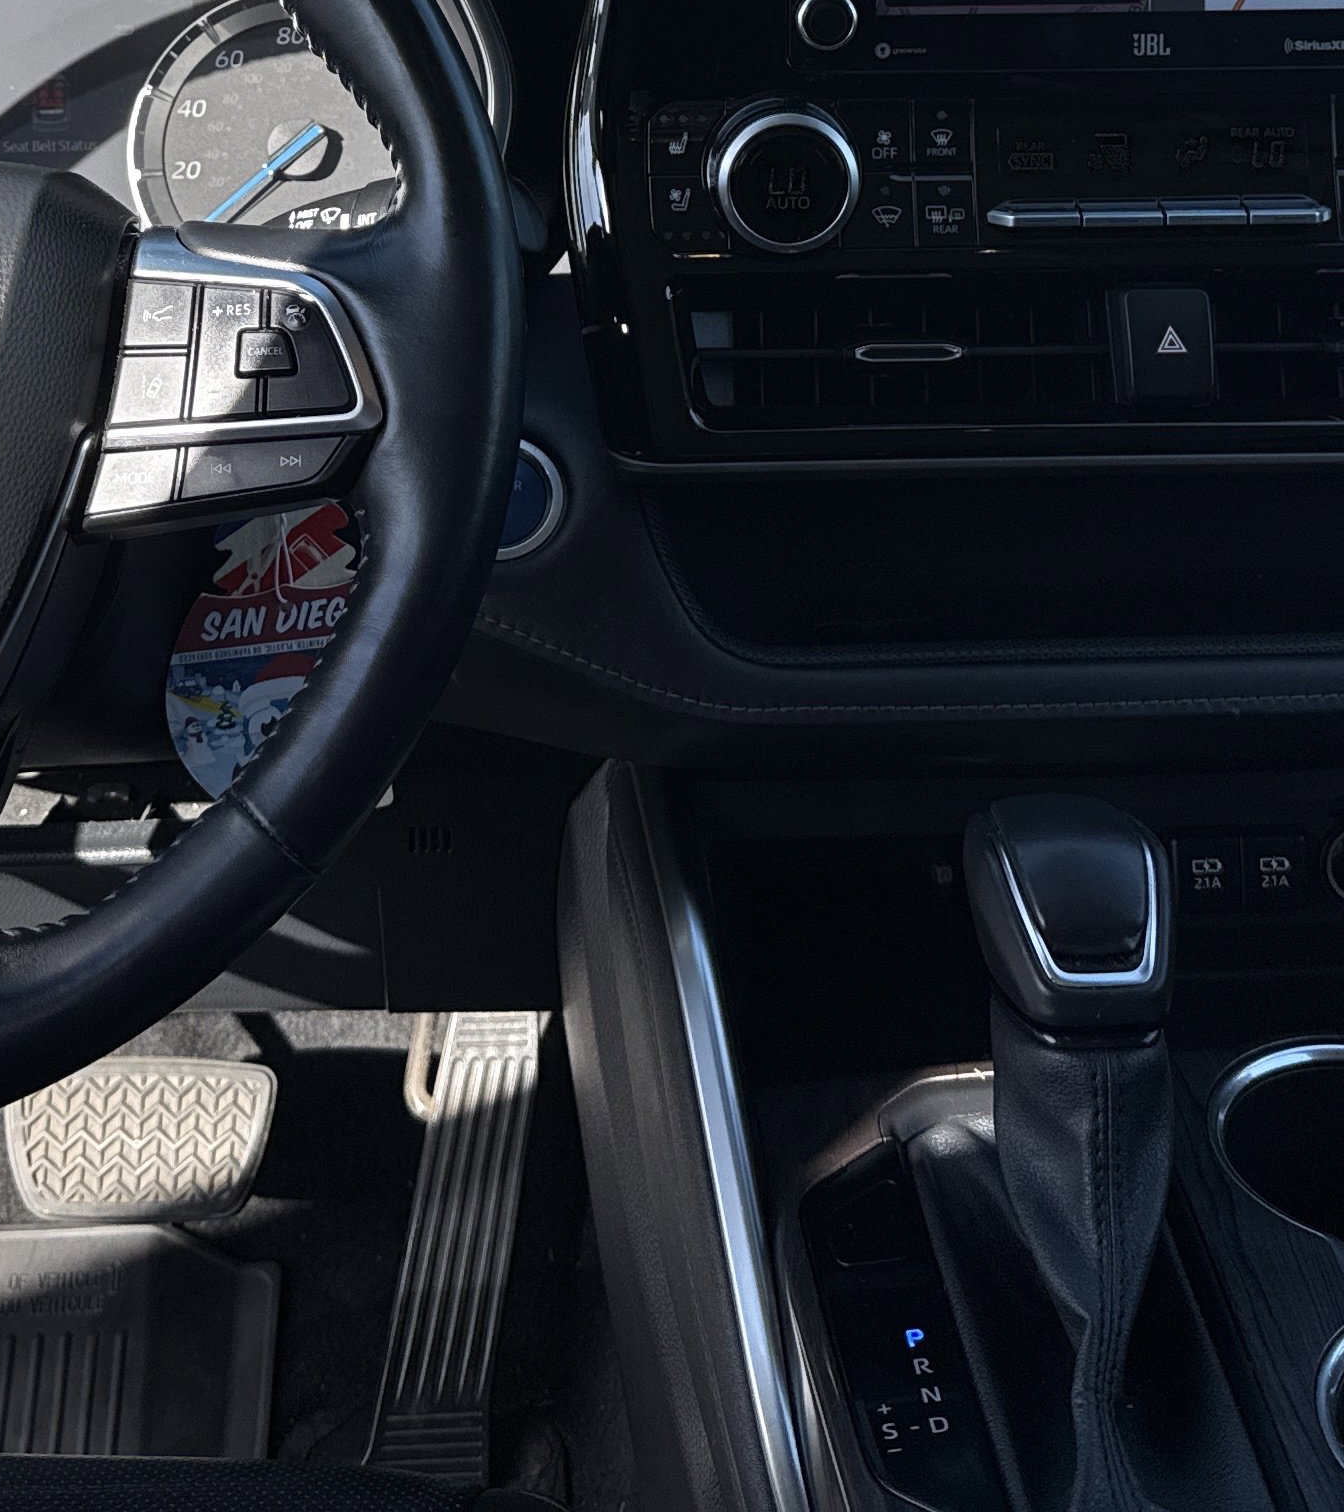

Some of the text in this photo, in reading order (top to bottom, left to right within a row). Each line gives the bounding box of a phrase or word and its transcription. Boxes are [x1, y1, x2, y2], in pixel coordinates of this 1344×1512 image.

[1133, 32, 1171, 56] JBL
[214, 50, 244, 68] 60
[176, 99, 207, 118] 40
[871, 147, 898, 160] OFF
[926, 148, 957, 157] FRONT
[171, 159, 202, 180] 20
[766, 196, 810, 209] AUTO
[932, 224, 959, 234] REAR
[226, 303, 251, 317] RES
[247, 346, 285, 357] CANCEL
[201, 595, 348, 641] SAN DIEG
[905, 1328, 925, 1348] P
[912, 1357, 934, 1375] R
[920, 1385, 942, 1404] N
[881, 1422, 899, 1440] S
[928, 1416, 949, 1434] D
